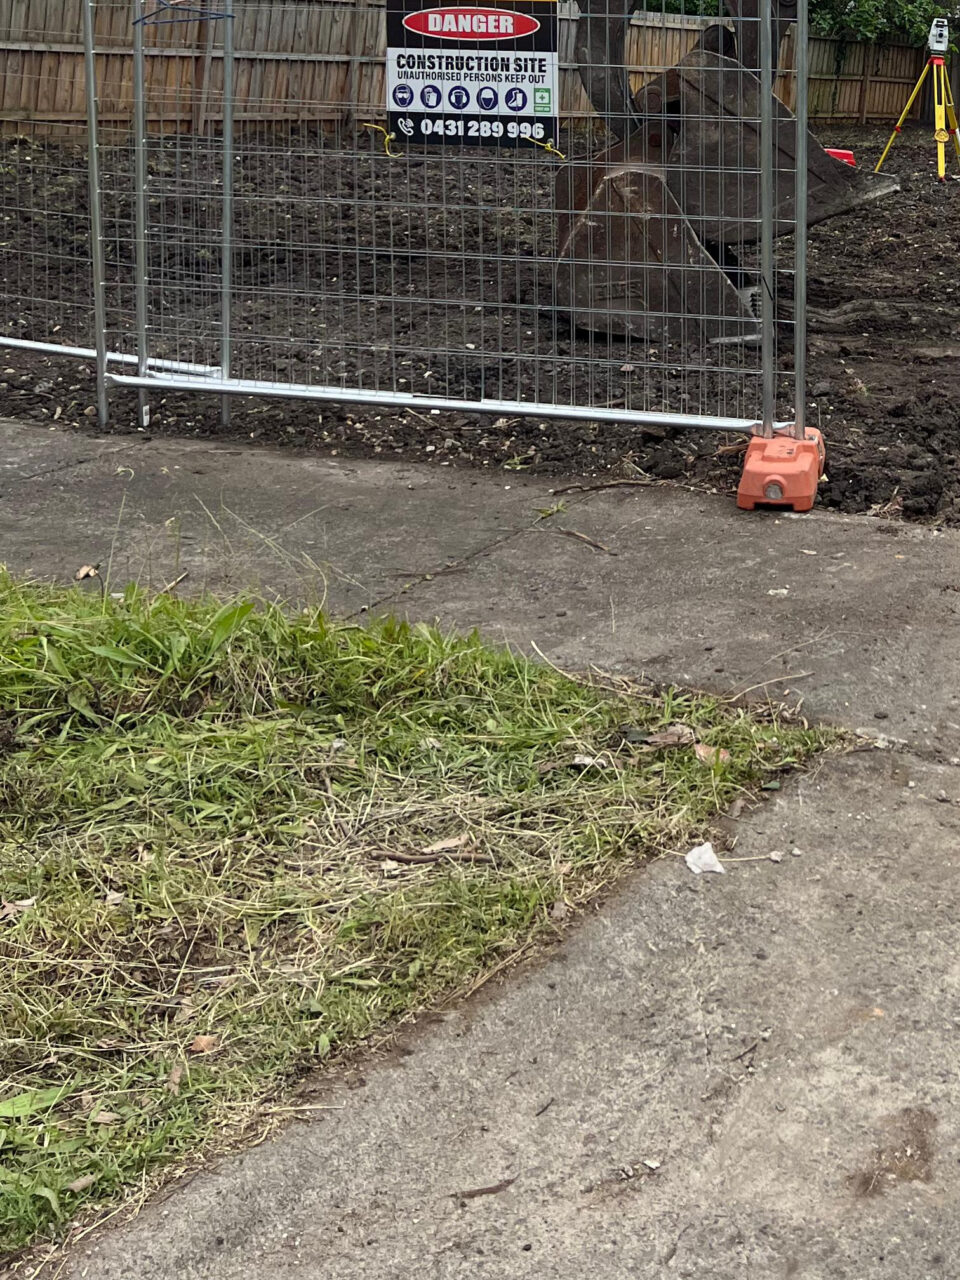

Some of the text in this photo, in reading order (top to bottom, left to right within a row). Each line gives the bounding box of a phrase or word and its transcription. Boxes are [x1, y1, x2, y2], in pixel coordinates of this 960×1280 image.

[428, 14, 514, 33] DANGER
[396, 54, 547, 73] CONSTRUCTION SITE
[397, 70, 546, 84] UNAUTHORISED PERSONS KEEP OUT
[420, 119, 545, 139] 0431 289 996
